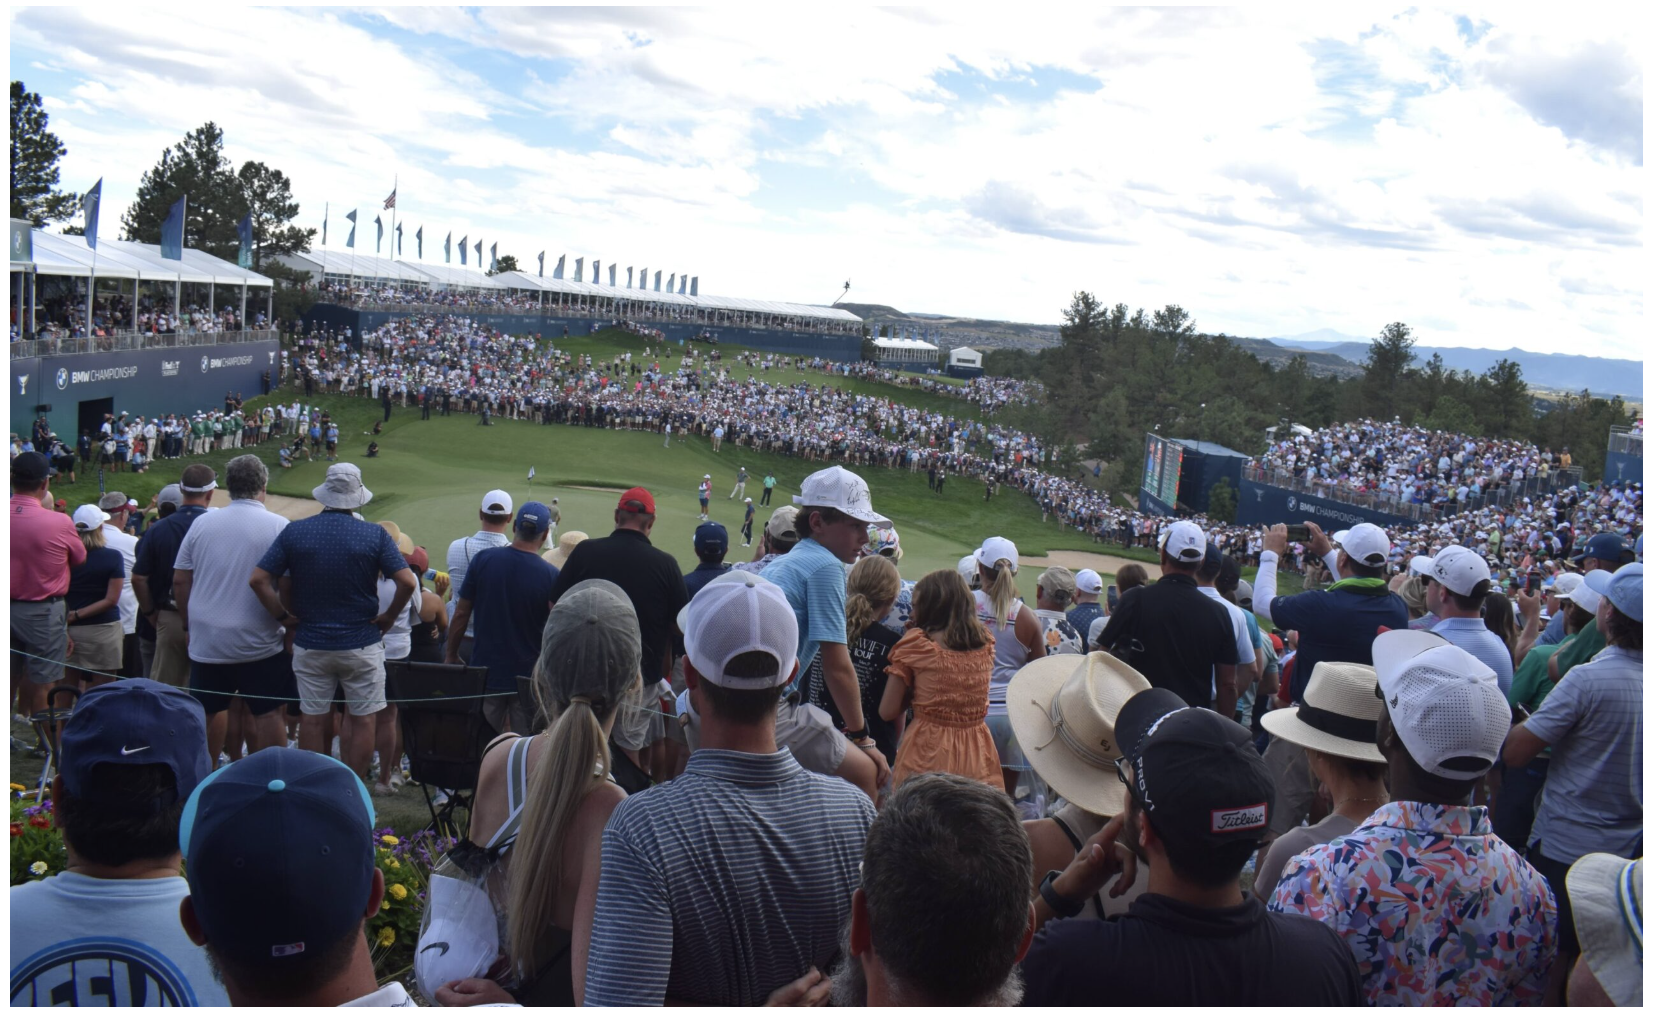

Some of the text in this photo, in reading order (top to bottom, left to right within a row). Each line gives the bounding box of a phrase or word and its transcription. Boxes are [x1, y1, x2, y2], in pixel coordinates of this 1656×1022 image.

[72, 366, 137, 384] BMW CHAMPIONSHIP
[1299, 502, 1364, 523] BMW CHAMPIONSHIP
[1137, 756, 1146, 791] PRO
[1217, 810, 1264, 830] Titleist
